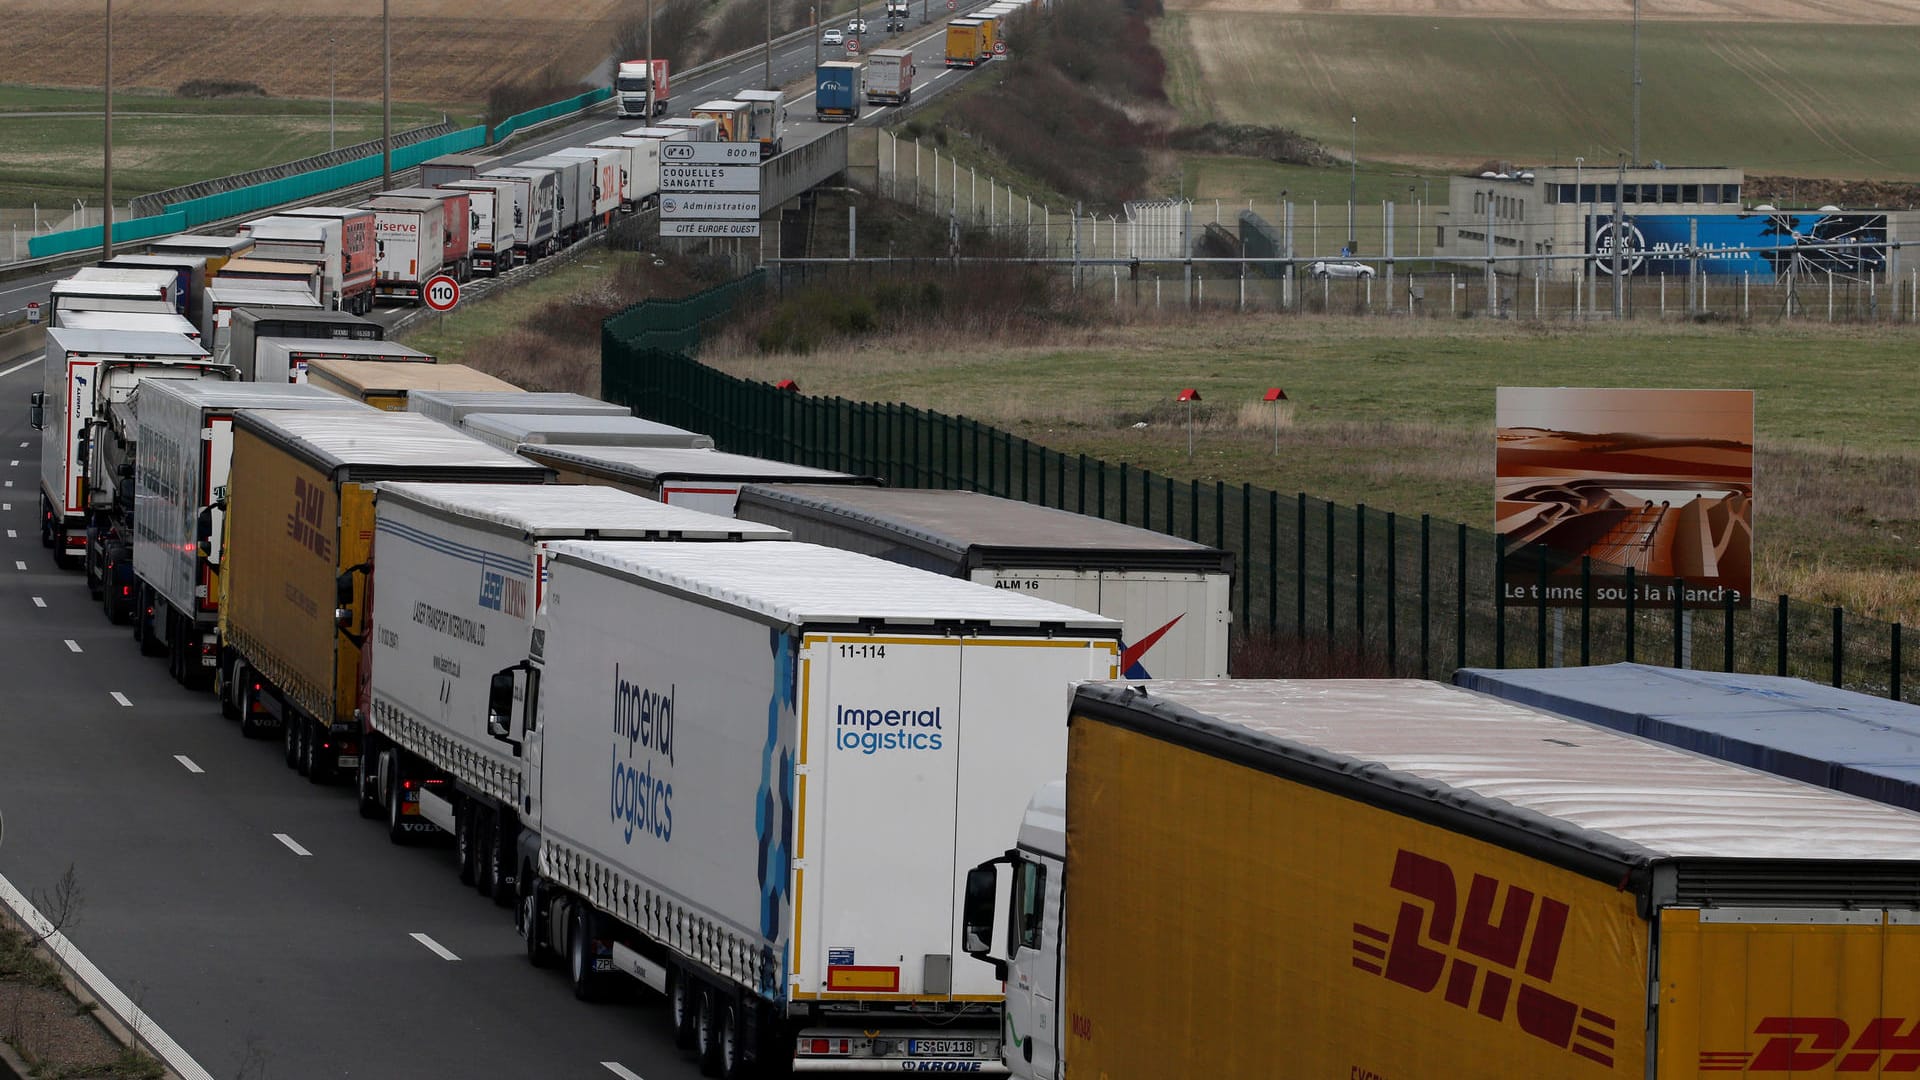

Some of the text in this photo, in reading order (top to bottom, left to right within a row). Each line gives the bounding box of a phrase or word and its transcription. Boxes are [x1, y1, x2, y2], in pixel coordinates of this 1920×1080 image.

[678, 148, 691, 156] 41
[727, 149, 747, 157] 800
[663, 169, 725, 177] COQUELLES
[663, 179, 715, 188] SANGATTE
[682, 201, 757, 211] Administration
[676, 223, 756, 233] CITÉ EUROPE OUEST
[431, 287, 453, 300] 110
[290, 476, 328, 559] DHL
[995, 580, 1039, 590] ALM 16
[1505, 583, 1525, 599] Le
[1530, 583, 1586, 600] tnne
[1645, 584, 1660, 600] la
[426, 604, 448, 635] TRANSPORT
[448, 613, 476, 644] INTERNATIONAL
[840, 644, 886, 659] 11-114
[614, 662, 675, 768] Imperial
[837, 704, 942, 731] Imperial
[837, 727, 942, 755] logistics
[610, 743, 673, 845] logistics
[1370, 848, 1597, 1058] DHL
[1727, 1016, 1920, 1072] DH
[918, 1061, 982, 1072] KRONE
